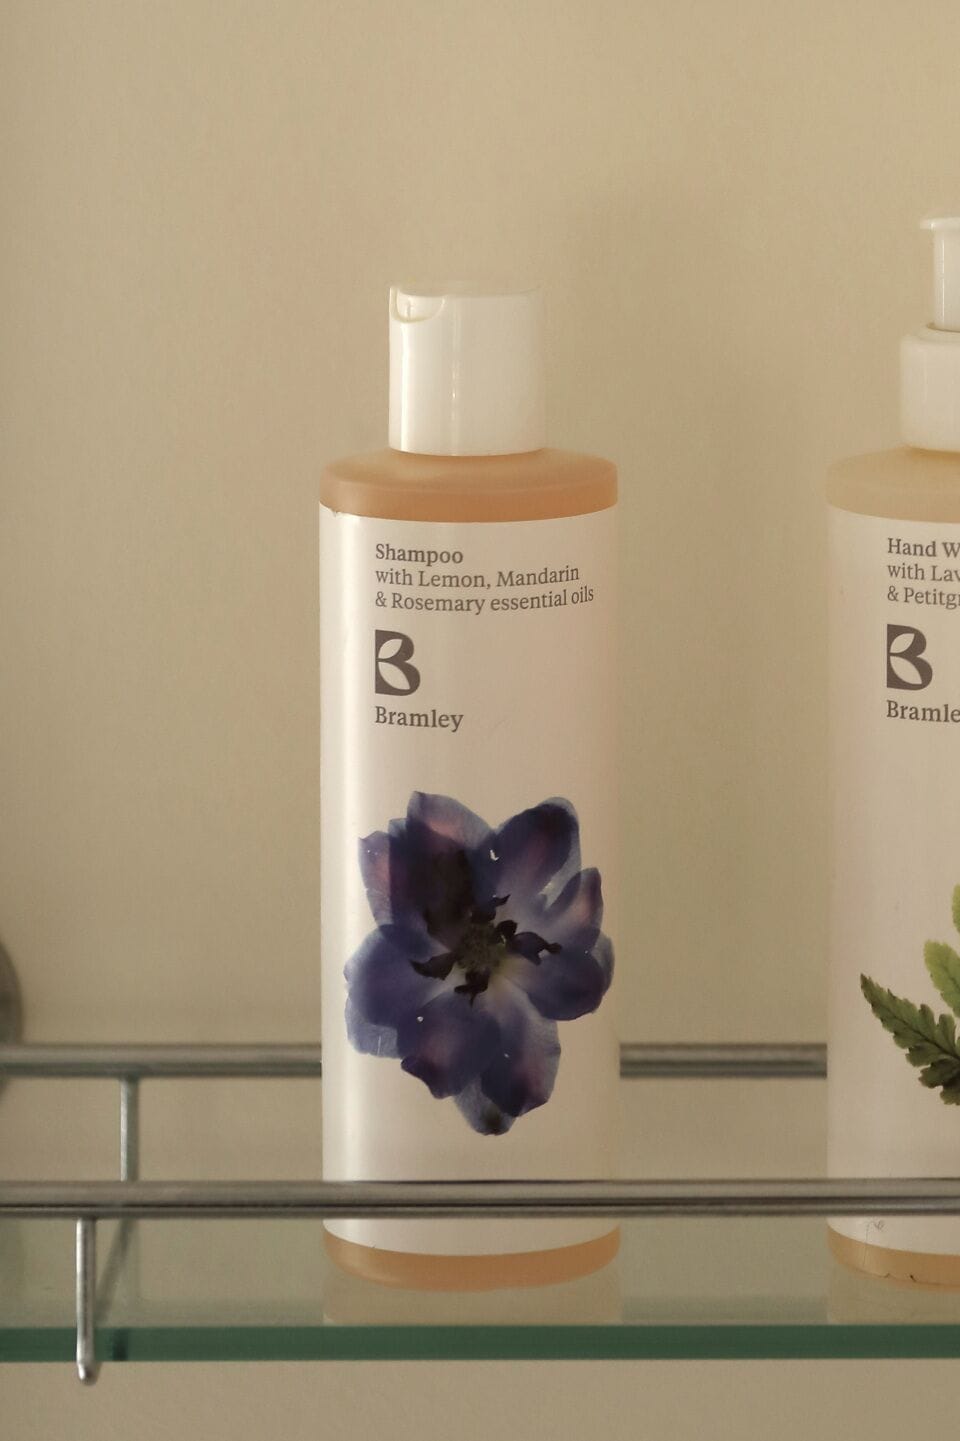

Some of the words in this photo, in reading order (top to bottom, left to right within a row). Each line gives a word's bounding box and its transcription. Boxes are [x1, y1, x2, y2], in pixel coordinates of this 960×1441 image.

[376, 543, 463, 566] Shampoo
[888, 538, 937, 557] Hand
[376, 568, 413, 585] with
[418, 571, 490, 589] Lemon,
[497, 565, 579, 587] Mandarin
[887, 563, 925, 580] with
[376, 592, 387, 607] &
[391, 593, 485, 615] Rosemary
[490, 590, 567, 610] essential
[571, 586, 593, 604] oils
[887, 586, 899, 601] &
[375, 706, 464, 732] Bramley
